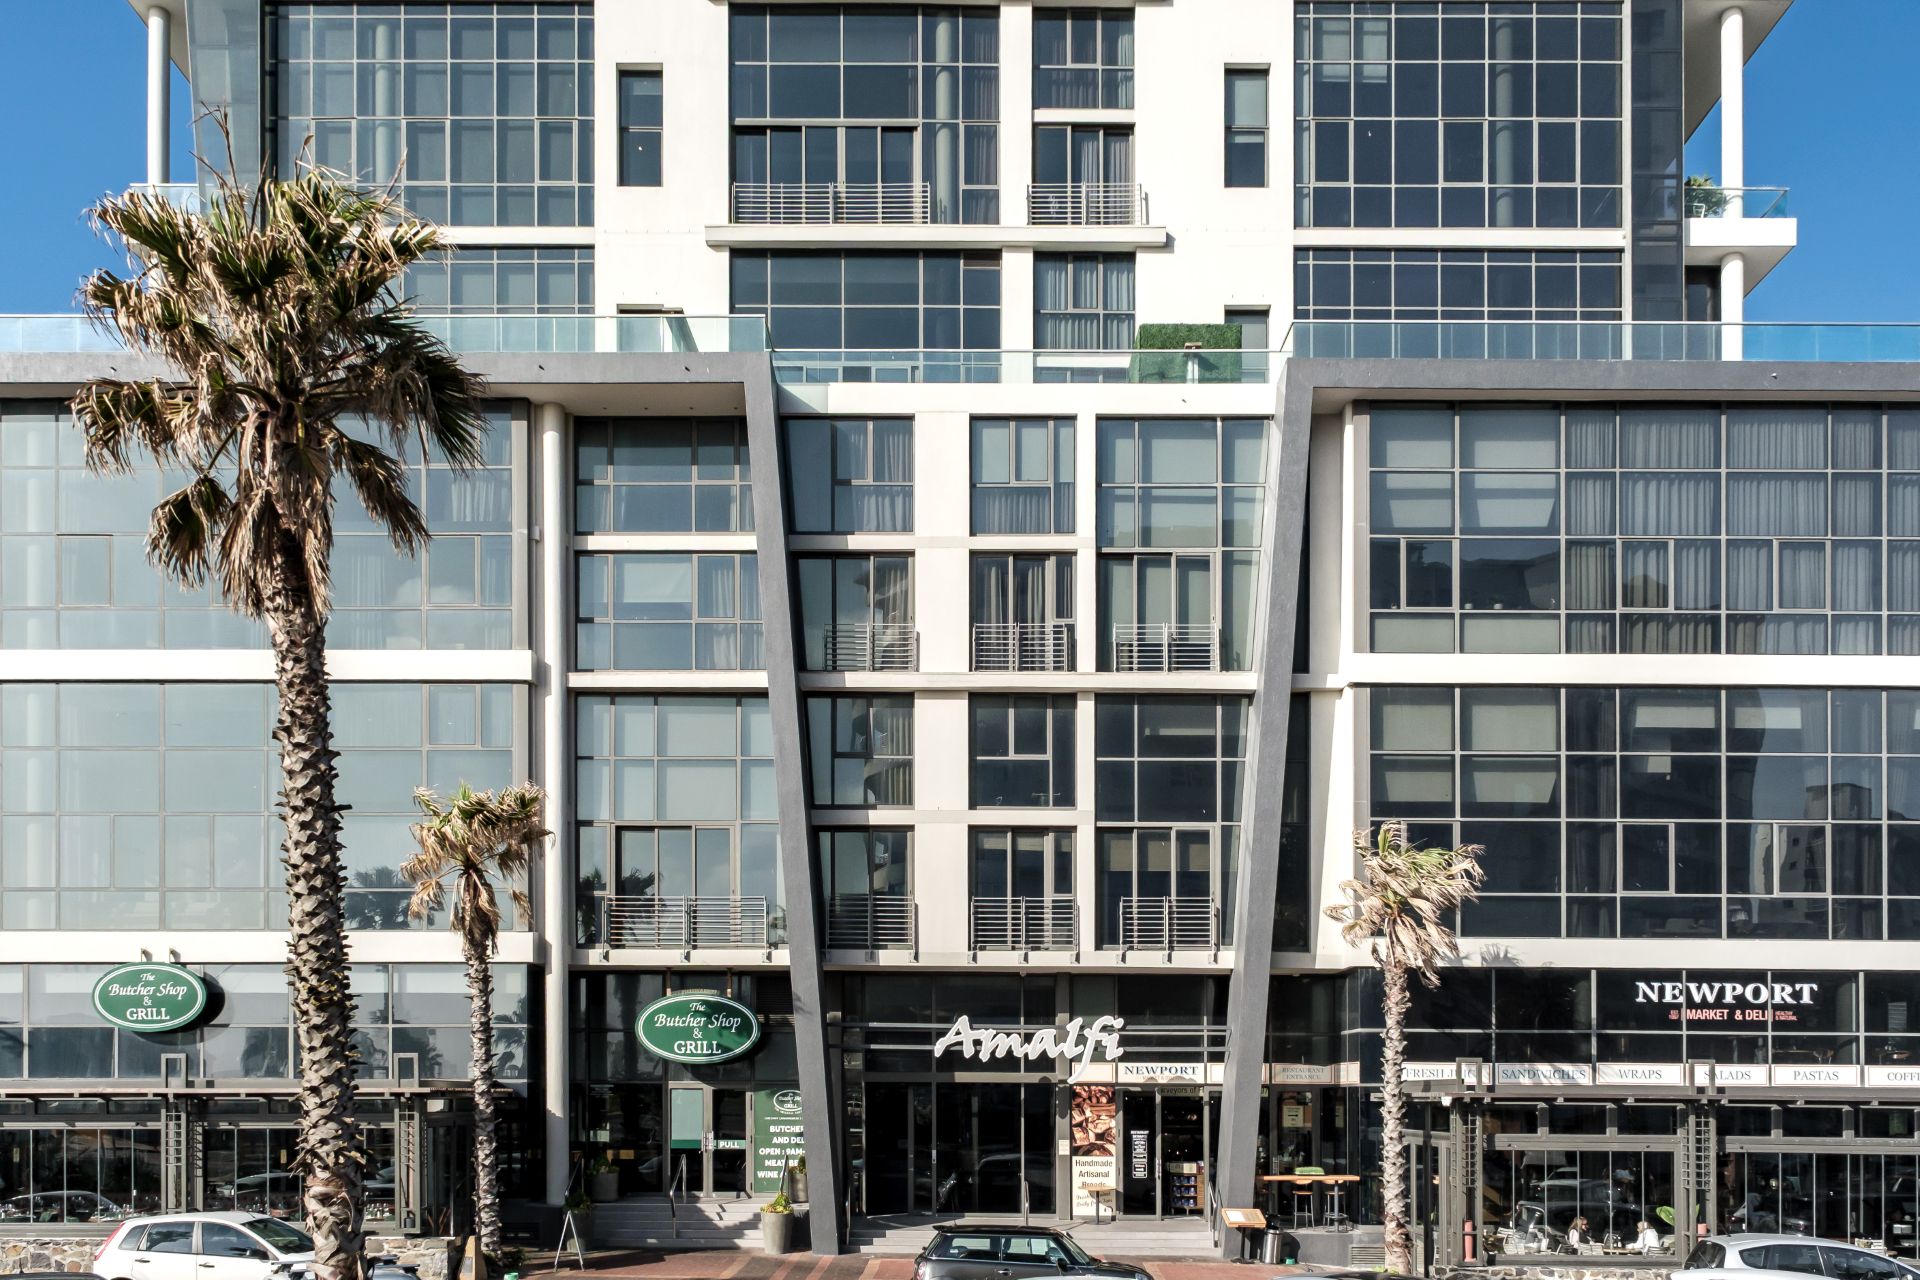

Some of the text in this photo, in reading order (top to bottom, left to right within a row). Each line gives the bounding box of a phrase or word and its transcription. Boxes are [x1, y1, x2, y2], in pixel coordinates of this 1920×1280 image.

[140, 972, 156, 981] The
[108, 981, 187, 1000] Butcher Shop
[1635, 981, 1818, 1004] NEWPORT
[143, 996, 152, 1006] &
[689, 1002, 706, 1011] The
[126, 1008, 170, 1020] GRILL
[1686, 1009, 1768, 1021] MARKET & DELI
[654, 1012, 741, 1033] Butcher Shop
[692, 1028, 703, 1039] &
[674, 1040, 721, 1054] GRILL
[934, 1014, 1125, 1084] Amalfi
[1124, 1065, 1199, 1075] NEWPORT
[1406, 1068, 1444, 1078] FRESH
[1502, 1069, 1587, 1080] SANDWICHES
[1618, 1069, 1662, 1080] WRAPS
[1793, 1071, 1839, 1081] PASTAS
[772, 1136, 789, 1144] AND
[759, 1147, 781, 1156] OPEN
[1075, 1159, 1113, 1167] Handmade
[757, 1170, 779, 1178] WINE
[1078, 1170, 1110, 1178] Artisanal
